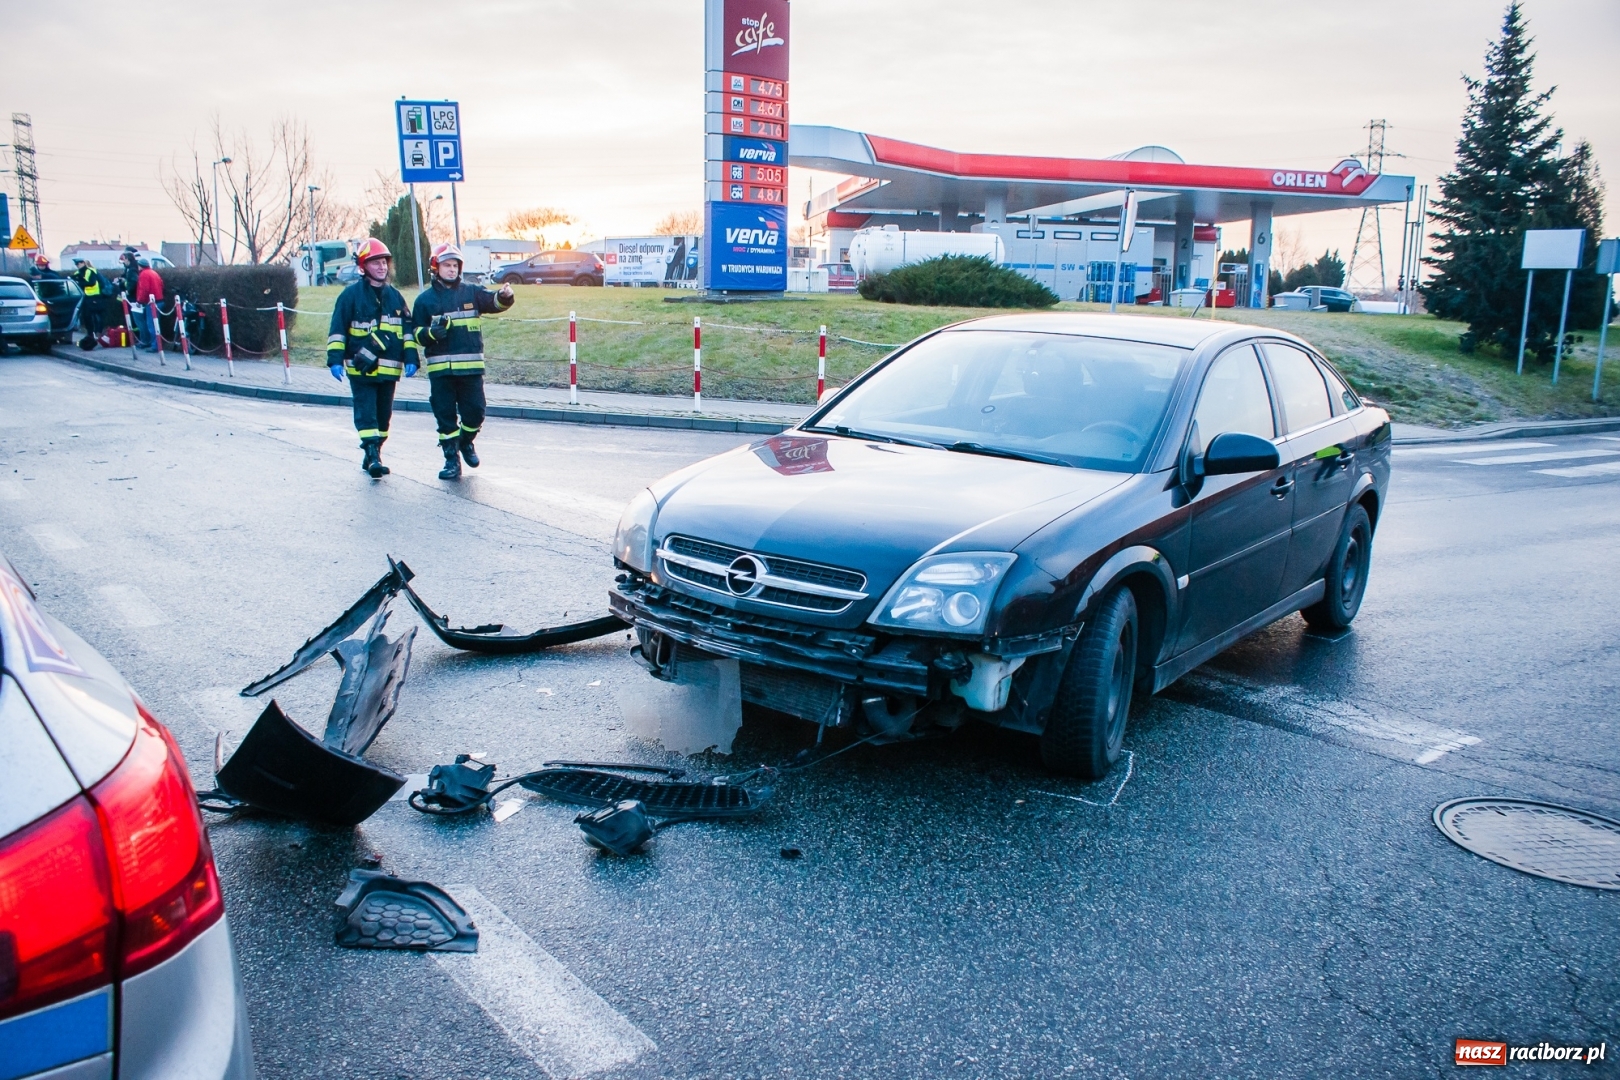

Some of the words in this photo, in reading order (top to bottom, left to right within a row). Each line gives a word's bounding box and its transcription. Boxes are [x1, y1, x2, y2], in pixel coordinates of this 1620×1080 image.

[741, 17, 759, 28] stop
[735, 12, 775, 54] cafe
[758, 81, 782, 97] 4.75
[433, 111, 454, 121] LPG
[758, 101, 782, 117] 4.67
[434, 121, 455, 130] GAZ
[758, 121, 782, 137] 2.16
[438, 141, 455, 167] P
[739, 147, 776, 162] verva
[732, 170, 743, 179] 98
[757, 167, 782, 182] 5.05
[1272, 171, 1327, 188] ORLEN
[731, 190, 743, 199] ON
[757, 187, 781, 202] 4.87
[725, 227, 779, 246] verva
[1181, 238, 1187, 249] 2
[1257, 232, 1265, 245] 6
[618, 243, 638, 254] Diesel
[639, 243, 664, 255] odporny
[618, 254, 627, 263] na
[721, 264, 727, 273] W
[728, 264, 755, 274] TRUDNYCH
[755, 265, 783, 275] WARUNKACH
[1061, 263, 1075, 271] SW
